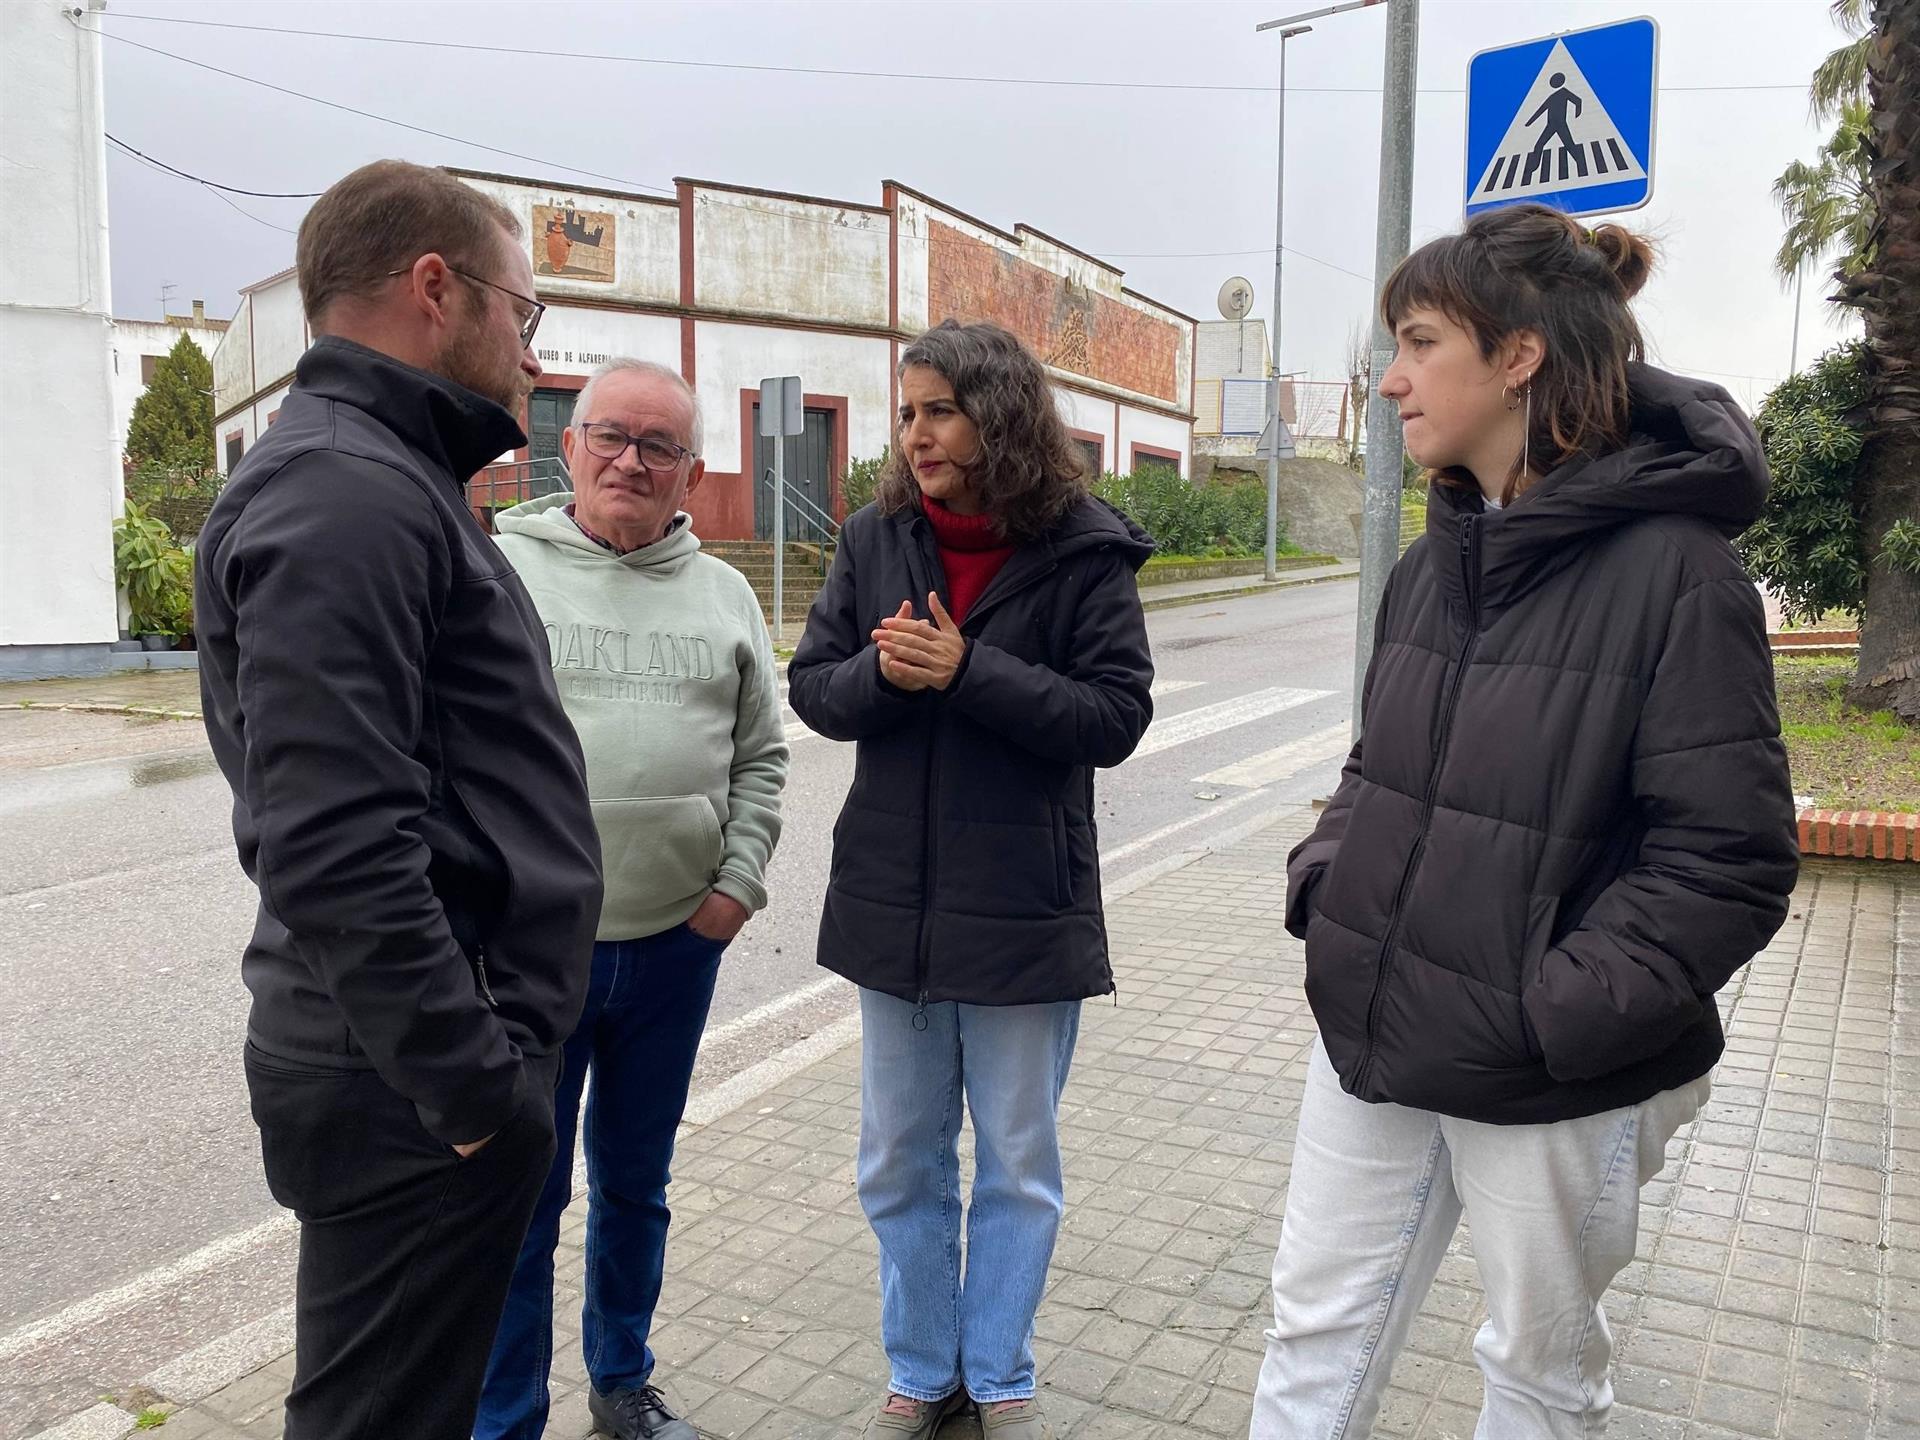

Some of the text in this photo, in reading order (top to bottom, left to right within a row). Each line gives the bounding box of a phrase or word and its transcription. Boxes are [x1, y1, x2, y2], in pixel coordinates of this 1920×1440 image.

[538, 349, 559, 361] MUSEO
[564, 351, 573, 363] DE
[544, 621, 714, 681] OAKLAND
[569, 676, 684, 705] CALIFORNIA
